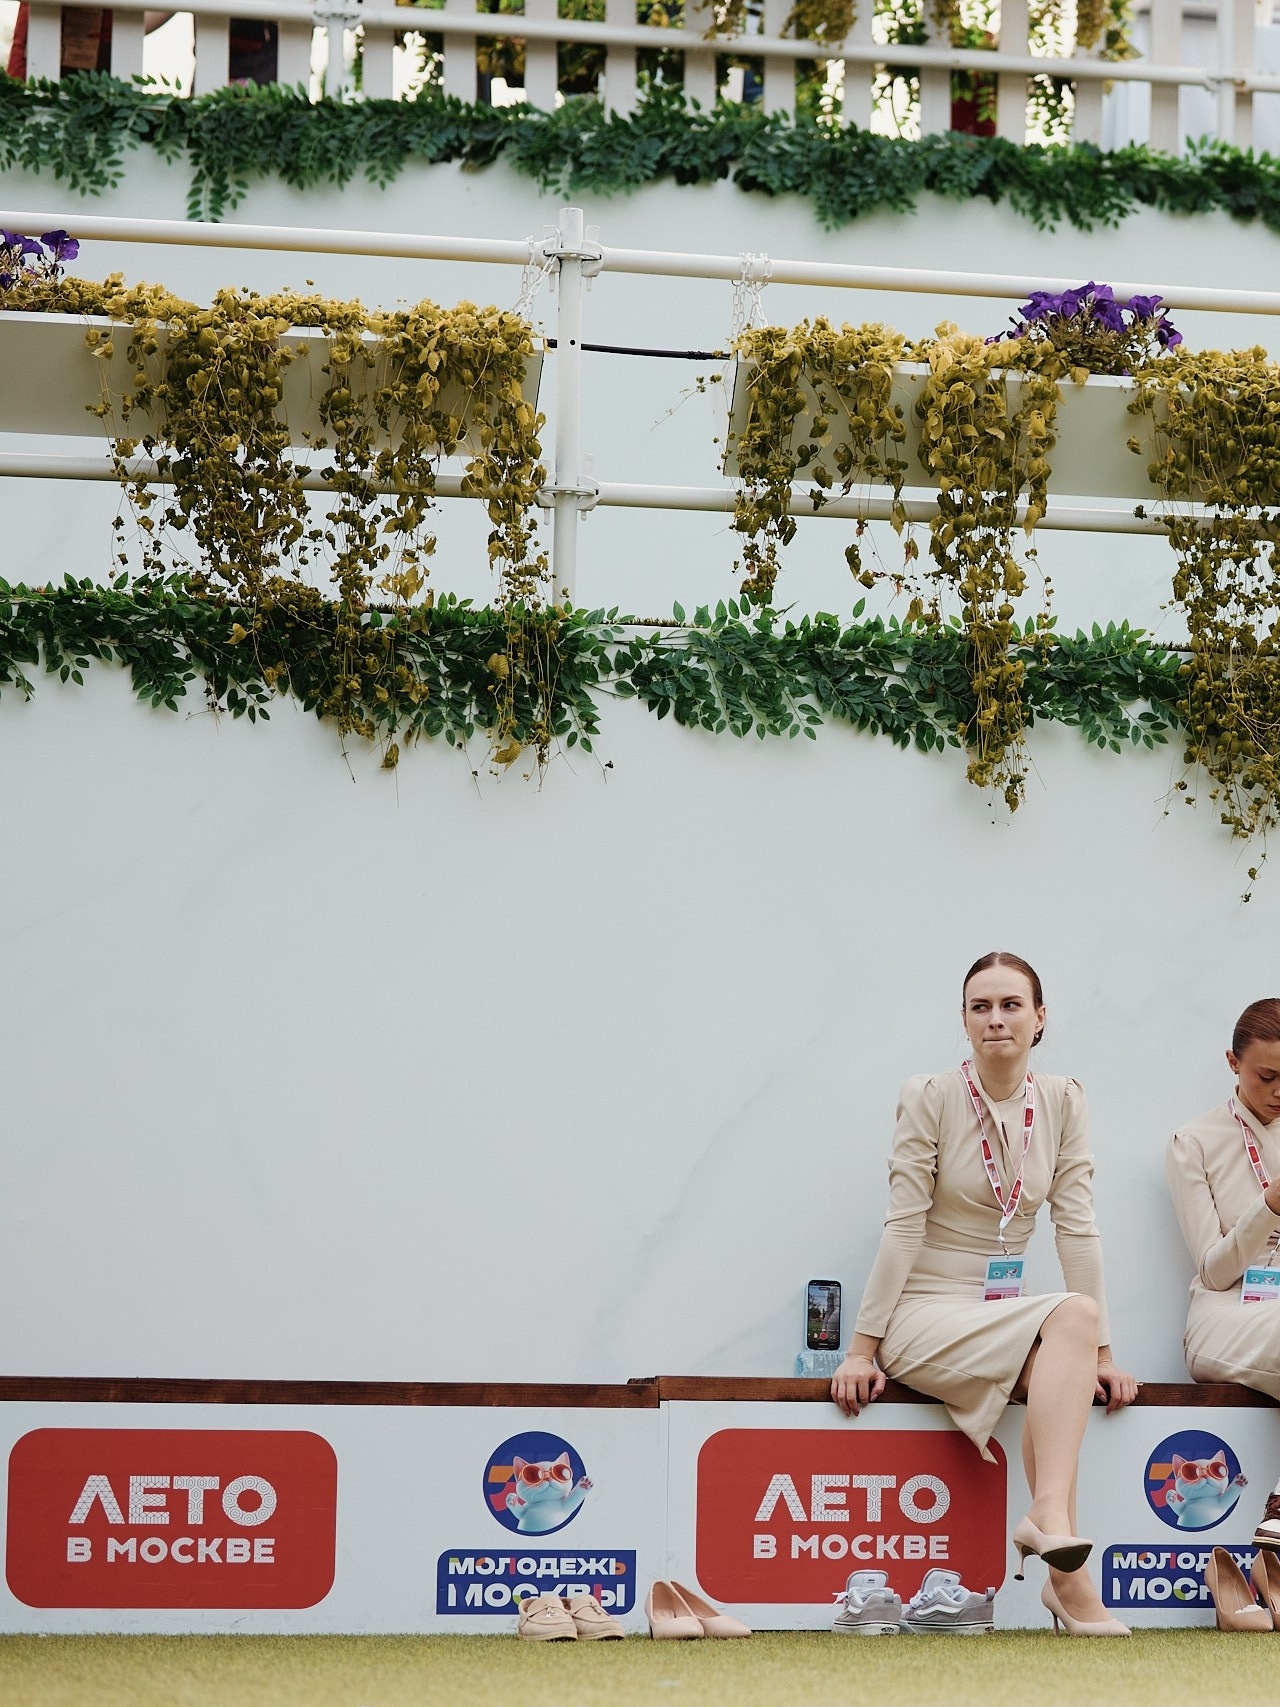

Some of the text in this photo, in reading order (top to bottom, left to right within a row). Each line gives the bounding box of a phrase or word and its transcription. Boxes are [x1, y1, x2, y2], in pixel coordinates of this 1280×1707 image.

[68, 1474, 278, 1527] ЛЕТО
[754, 1473, 951, 1524] ЛЕТО
[66, 1536, 276, 1564] В МОСКВЕ
[753, 1533, 950, 1560] В МОСКВЕ
[448, 1556, 627, 1579] МОЛОДЕЖЬ
